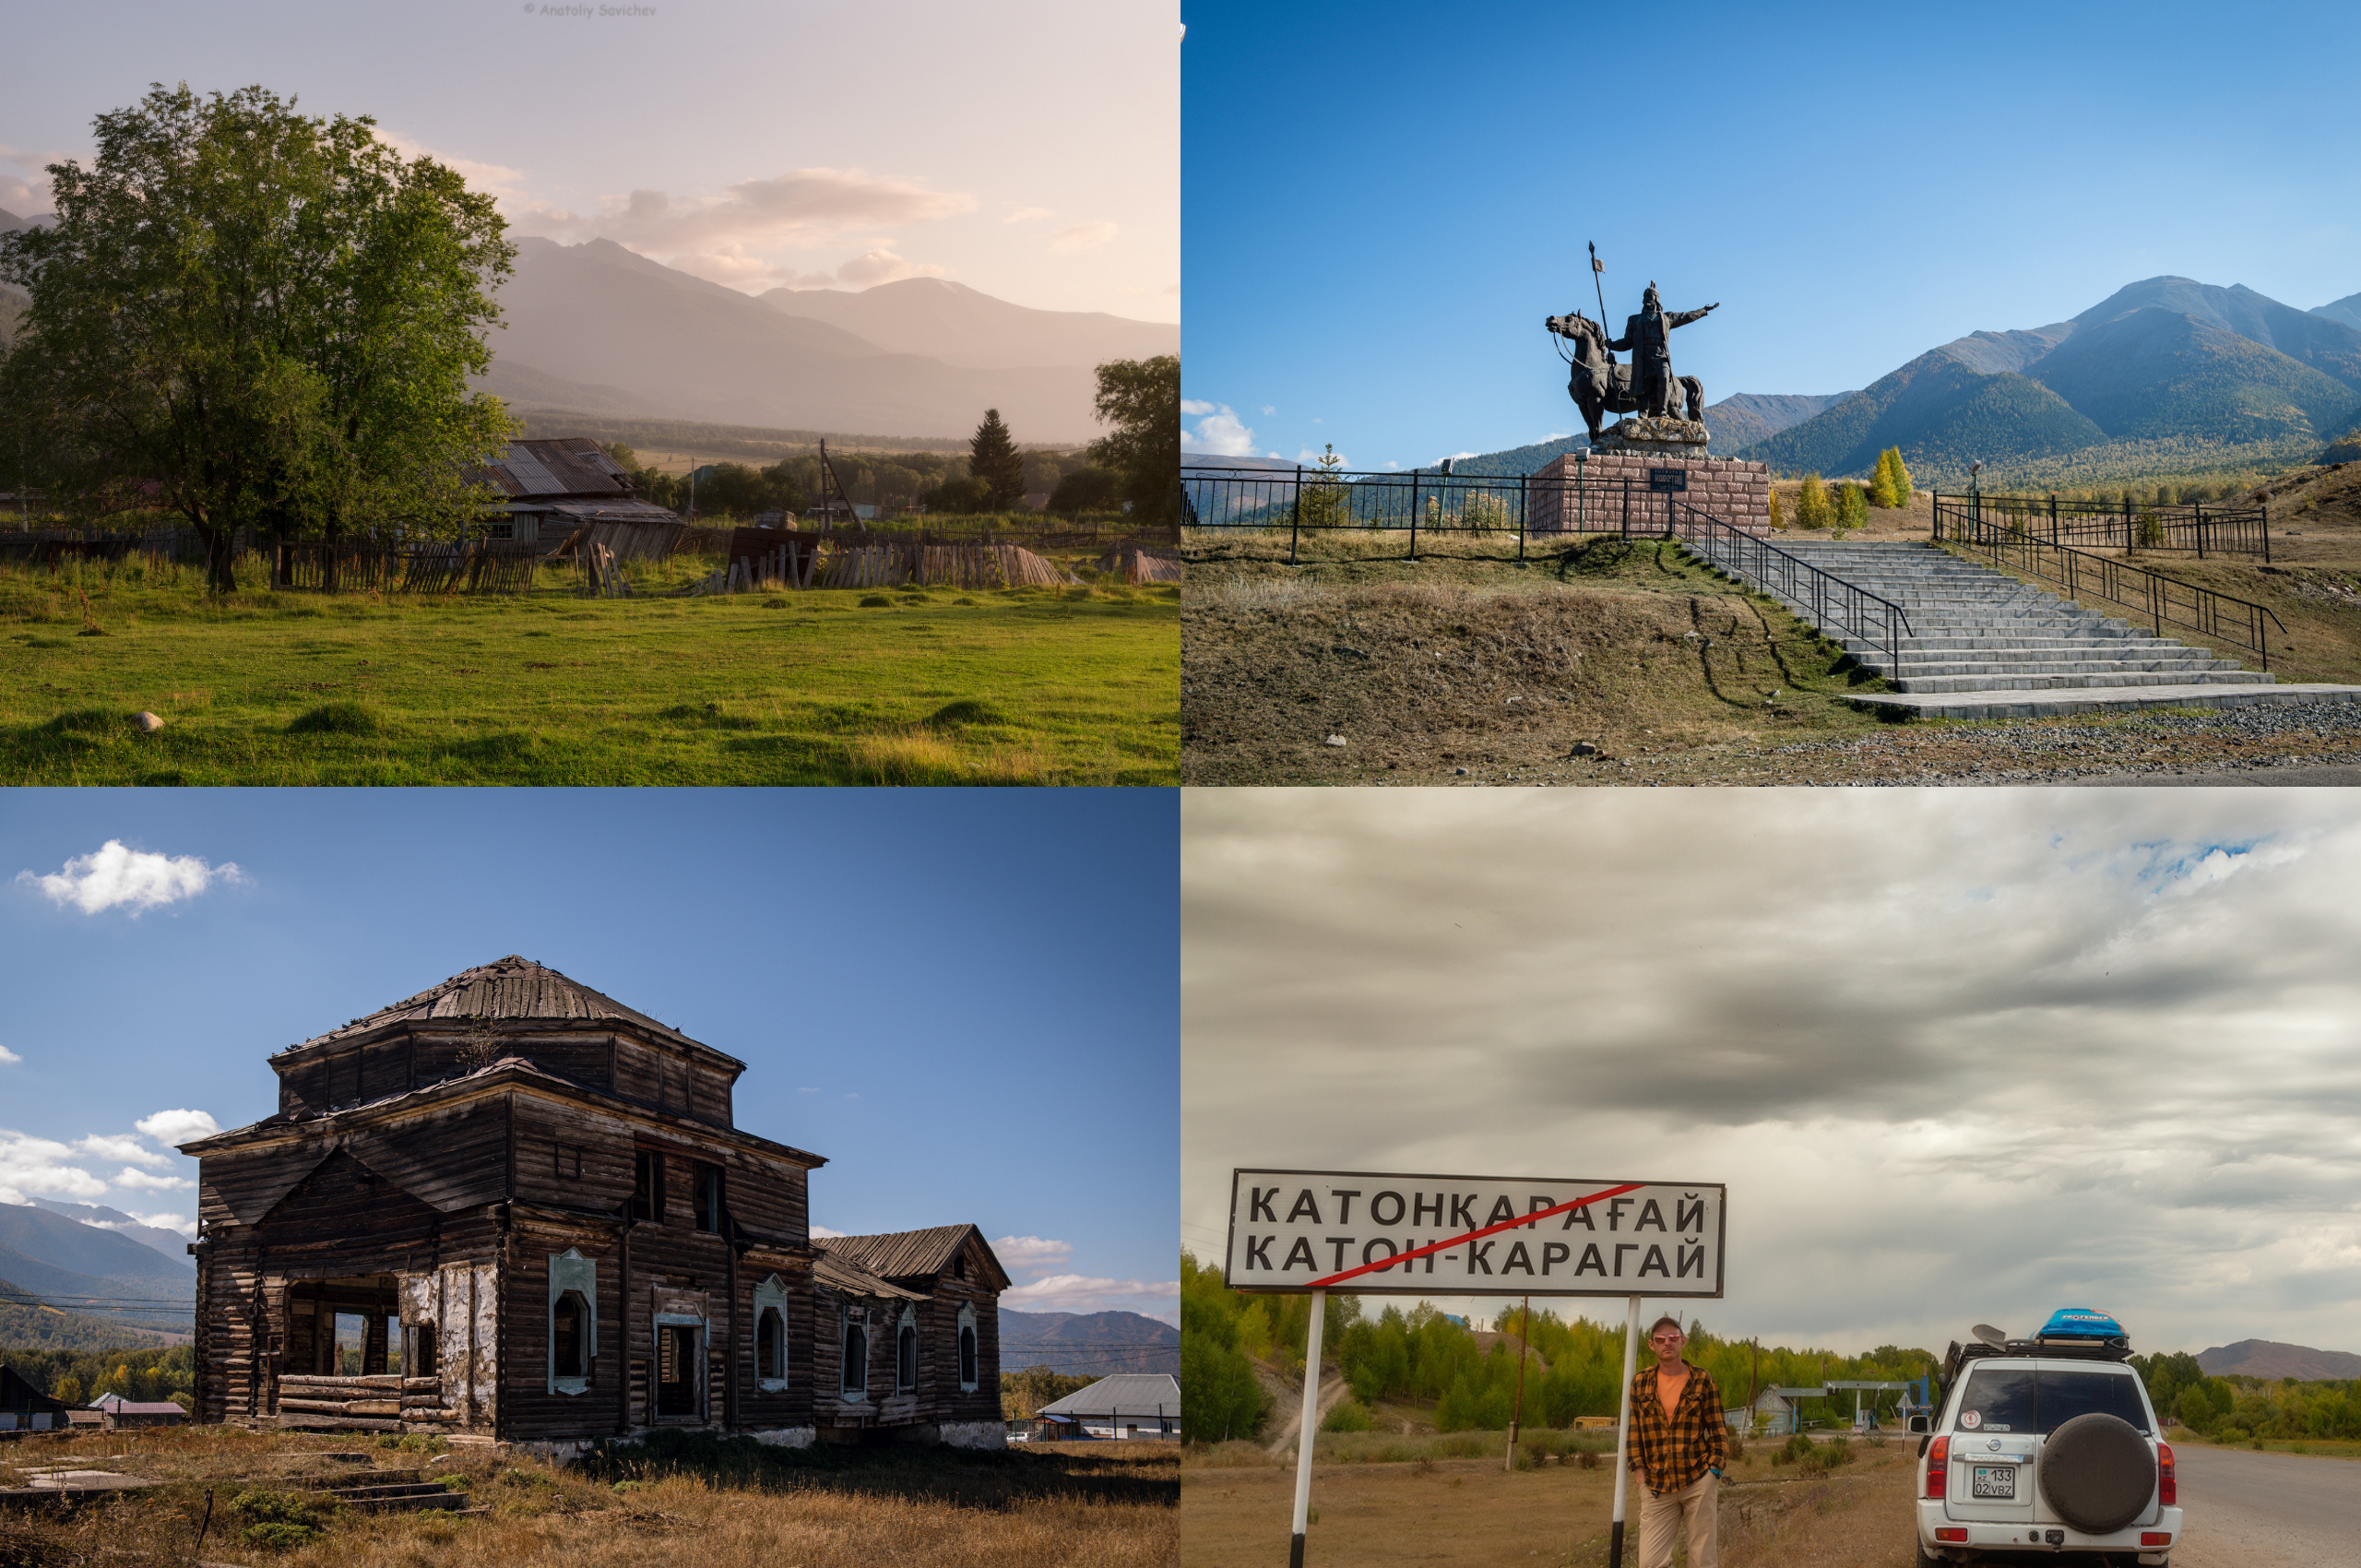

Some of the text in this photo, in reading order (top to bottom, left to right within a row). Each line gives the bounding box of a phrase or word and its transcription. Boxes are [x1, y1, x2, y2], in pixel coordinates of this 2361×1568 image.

[1249, 1186, 1705, 1234] КАТОНҚАРАҒАЙ
[1245, 1234, 1705, 1278] КАТОН-КАРАГАЙ
[1975, 1483, 2011, 1495] 02 VBZ
[1990, 1469, 2011, 1481] 133
